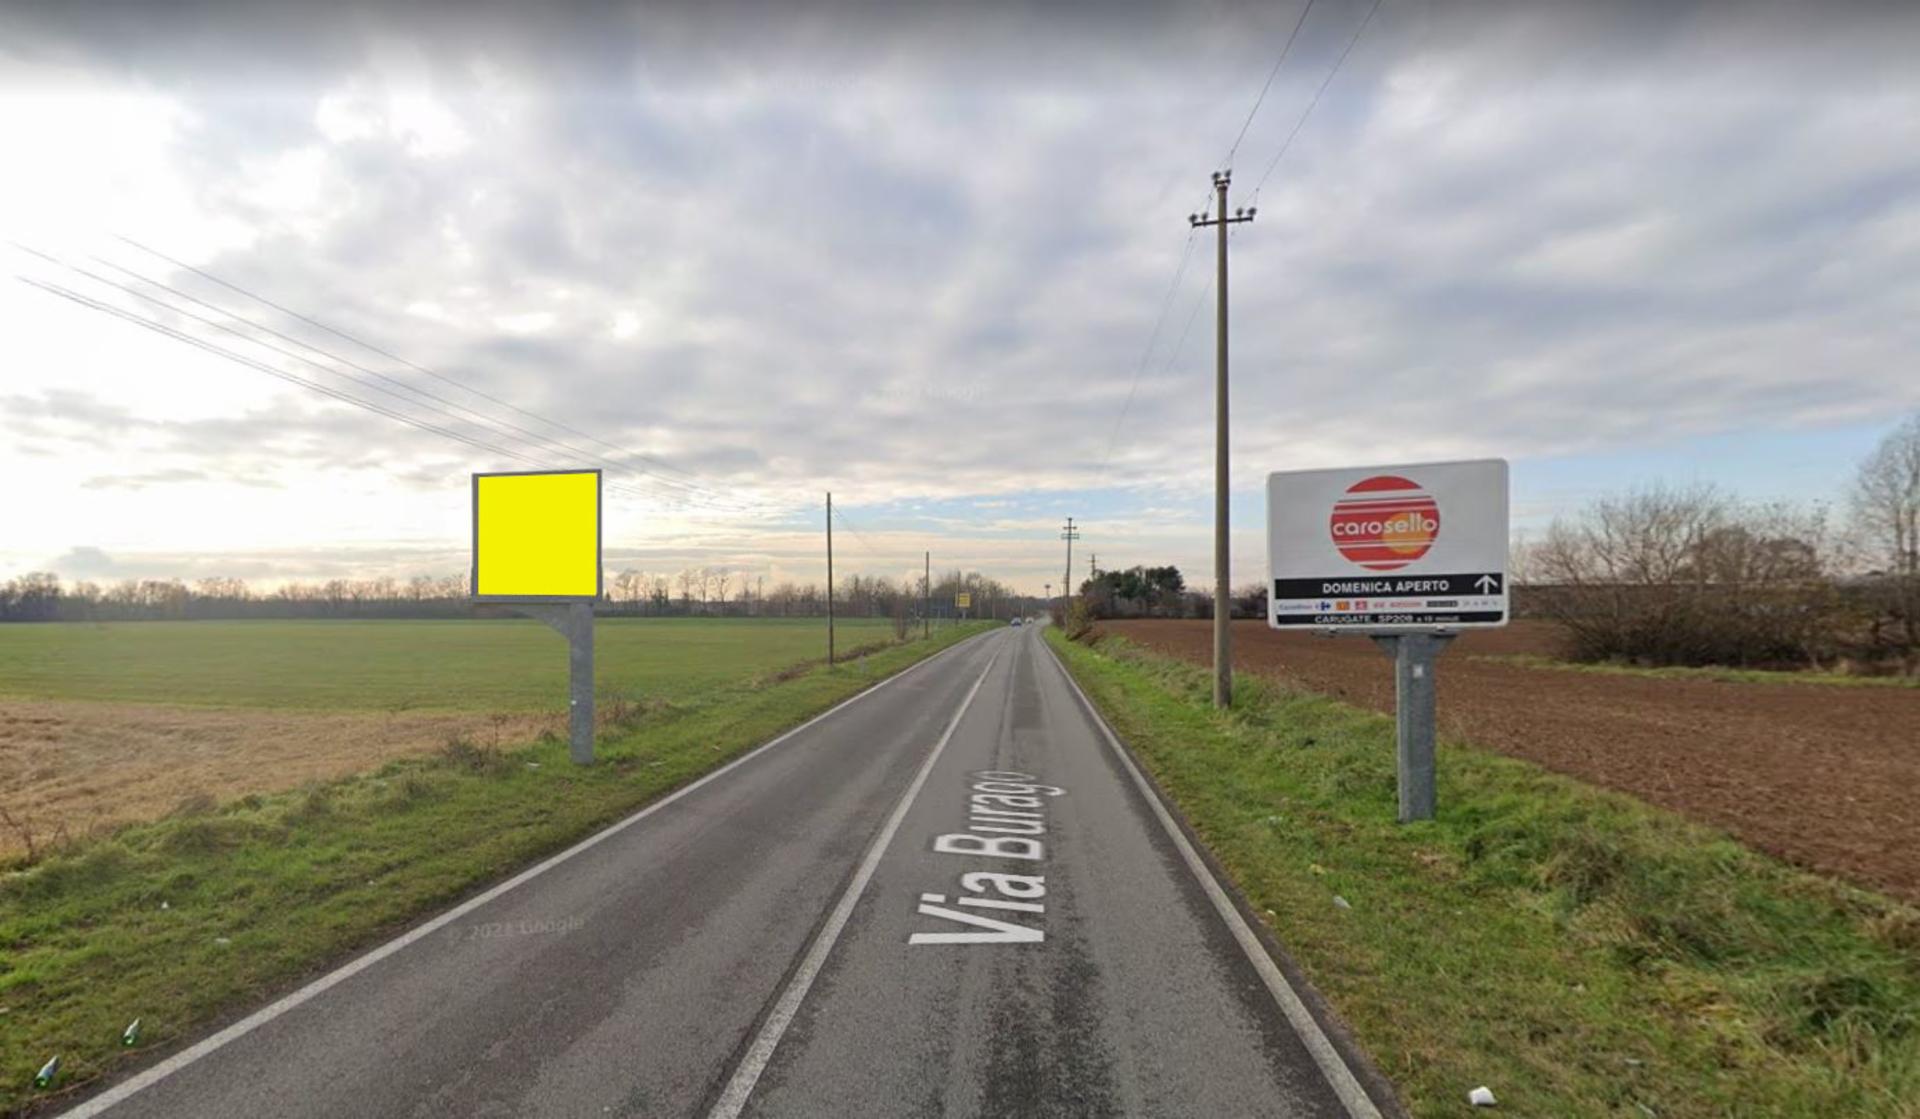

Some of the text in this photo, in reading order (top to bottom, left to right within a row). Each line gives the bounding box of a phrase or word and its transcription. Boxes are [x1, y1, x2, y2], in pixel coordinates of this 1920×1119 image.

[1332, 512, 1438, 537] carosello
[1322, 578, 1450, 595] DOMENICA APERTO
